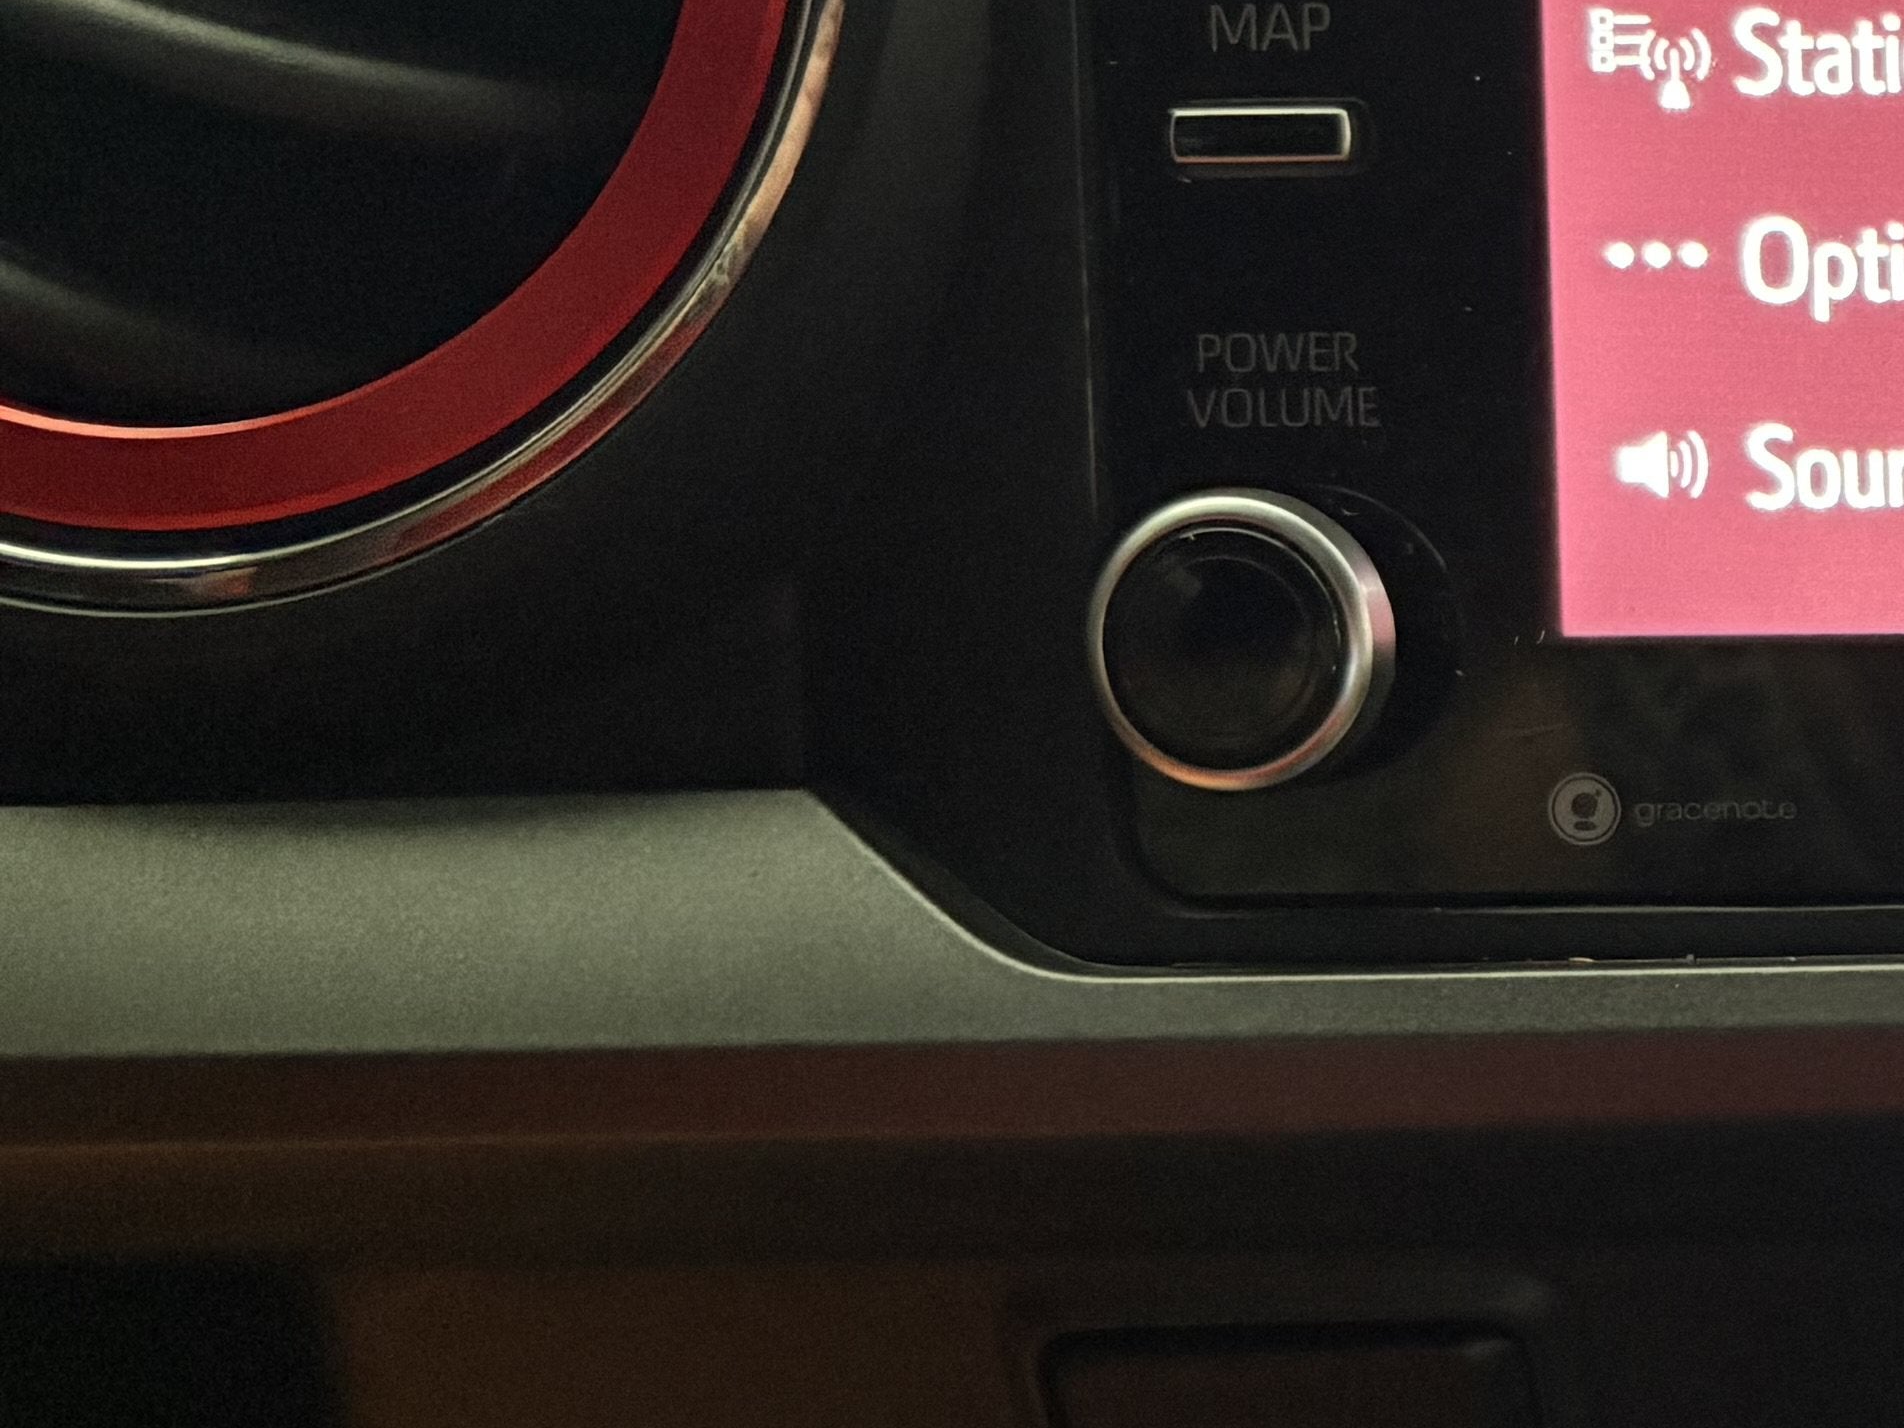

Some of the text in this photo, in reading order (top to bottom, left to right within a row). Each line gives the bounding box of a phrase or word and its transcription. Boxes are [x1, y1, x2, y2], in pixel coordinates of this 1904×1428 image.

[1210, 2, 1331, 53] MAP
[1199, 331, 1359, 372] POWER
[1187, 386, 1381, 428] VOLUME
[1634, 799, 1797, 827] gracenote
